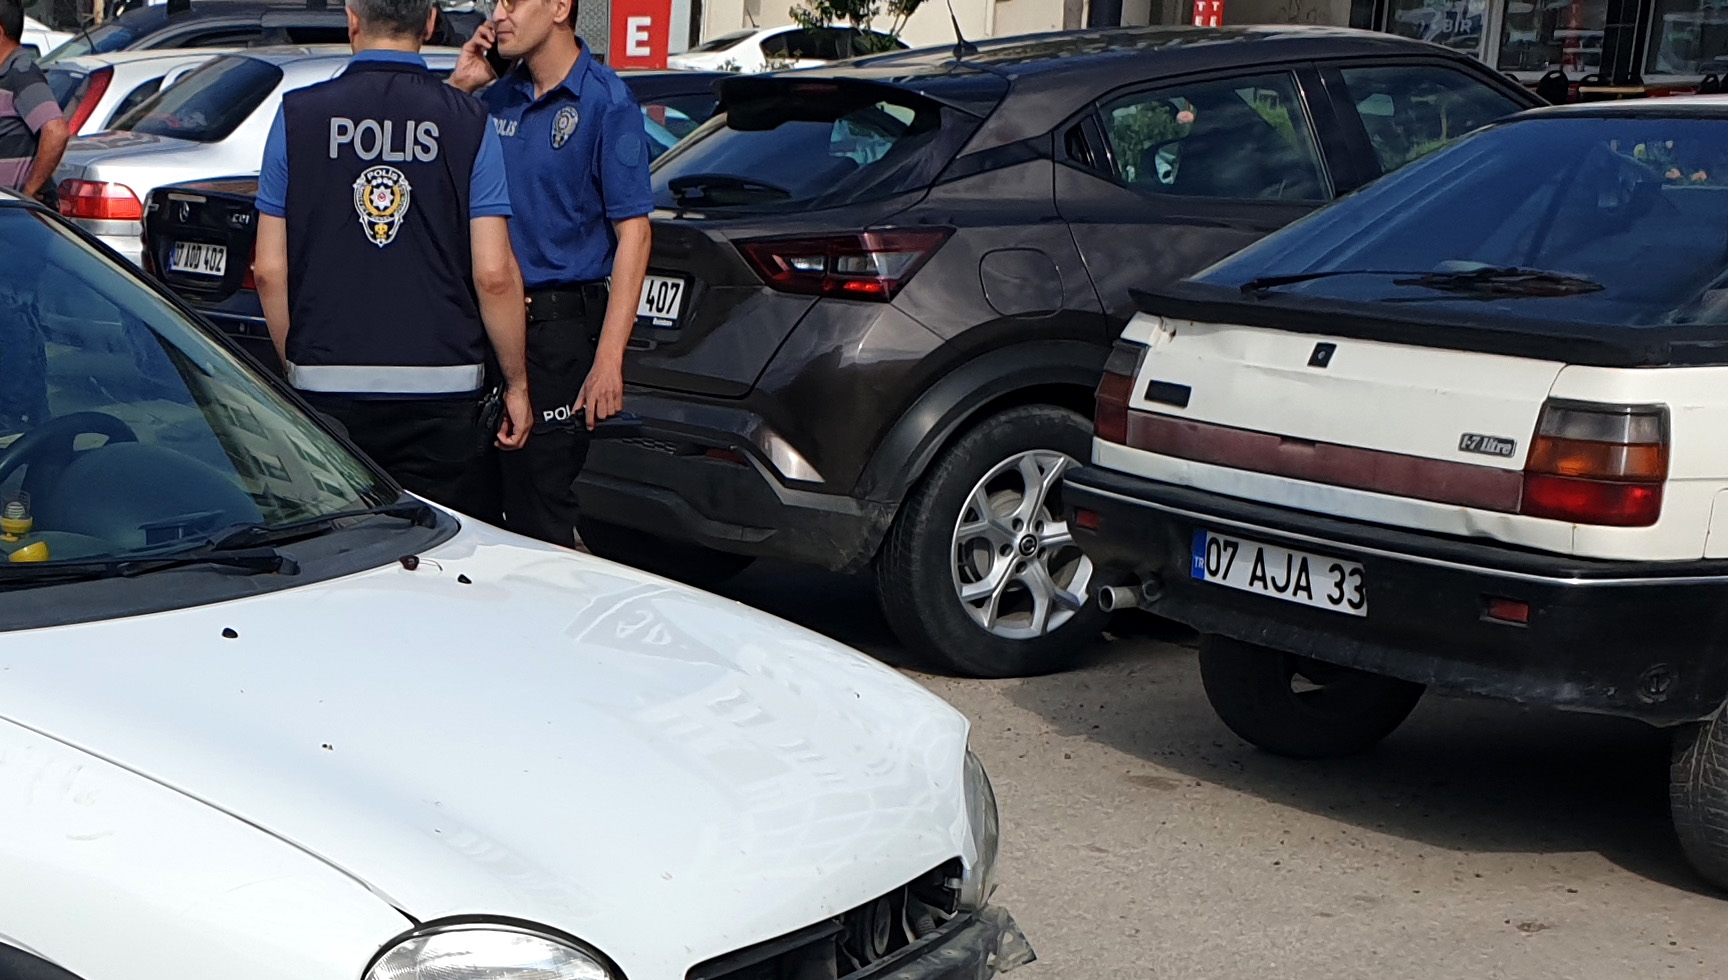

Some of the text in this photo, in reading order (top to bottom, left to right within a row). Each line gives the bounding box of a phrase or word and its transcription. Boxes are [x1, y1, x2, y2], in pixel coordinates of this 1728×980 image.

[626, 16, 651, 56] E
[329, 117, 440, 162] POLIS
[204, 246, 224, 273] 402
[646, 279, 681, 315] 407
[1480, 437, 1512, 455] litre
[1206, 536, 1366, 610] 07 AJA 33
